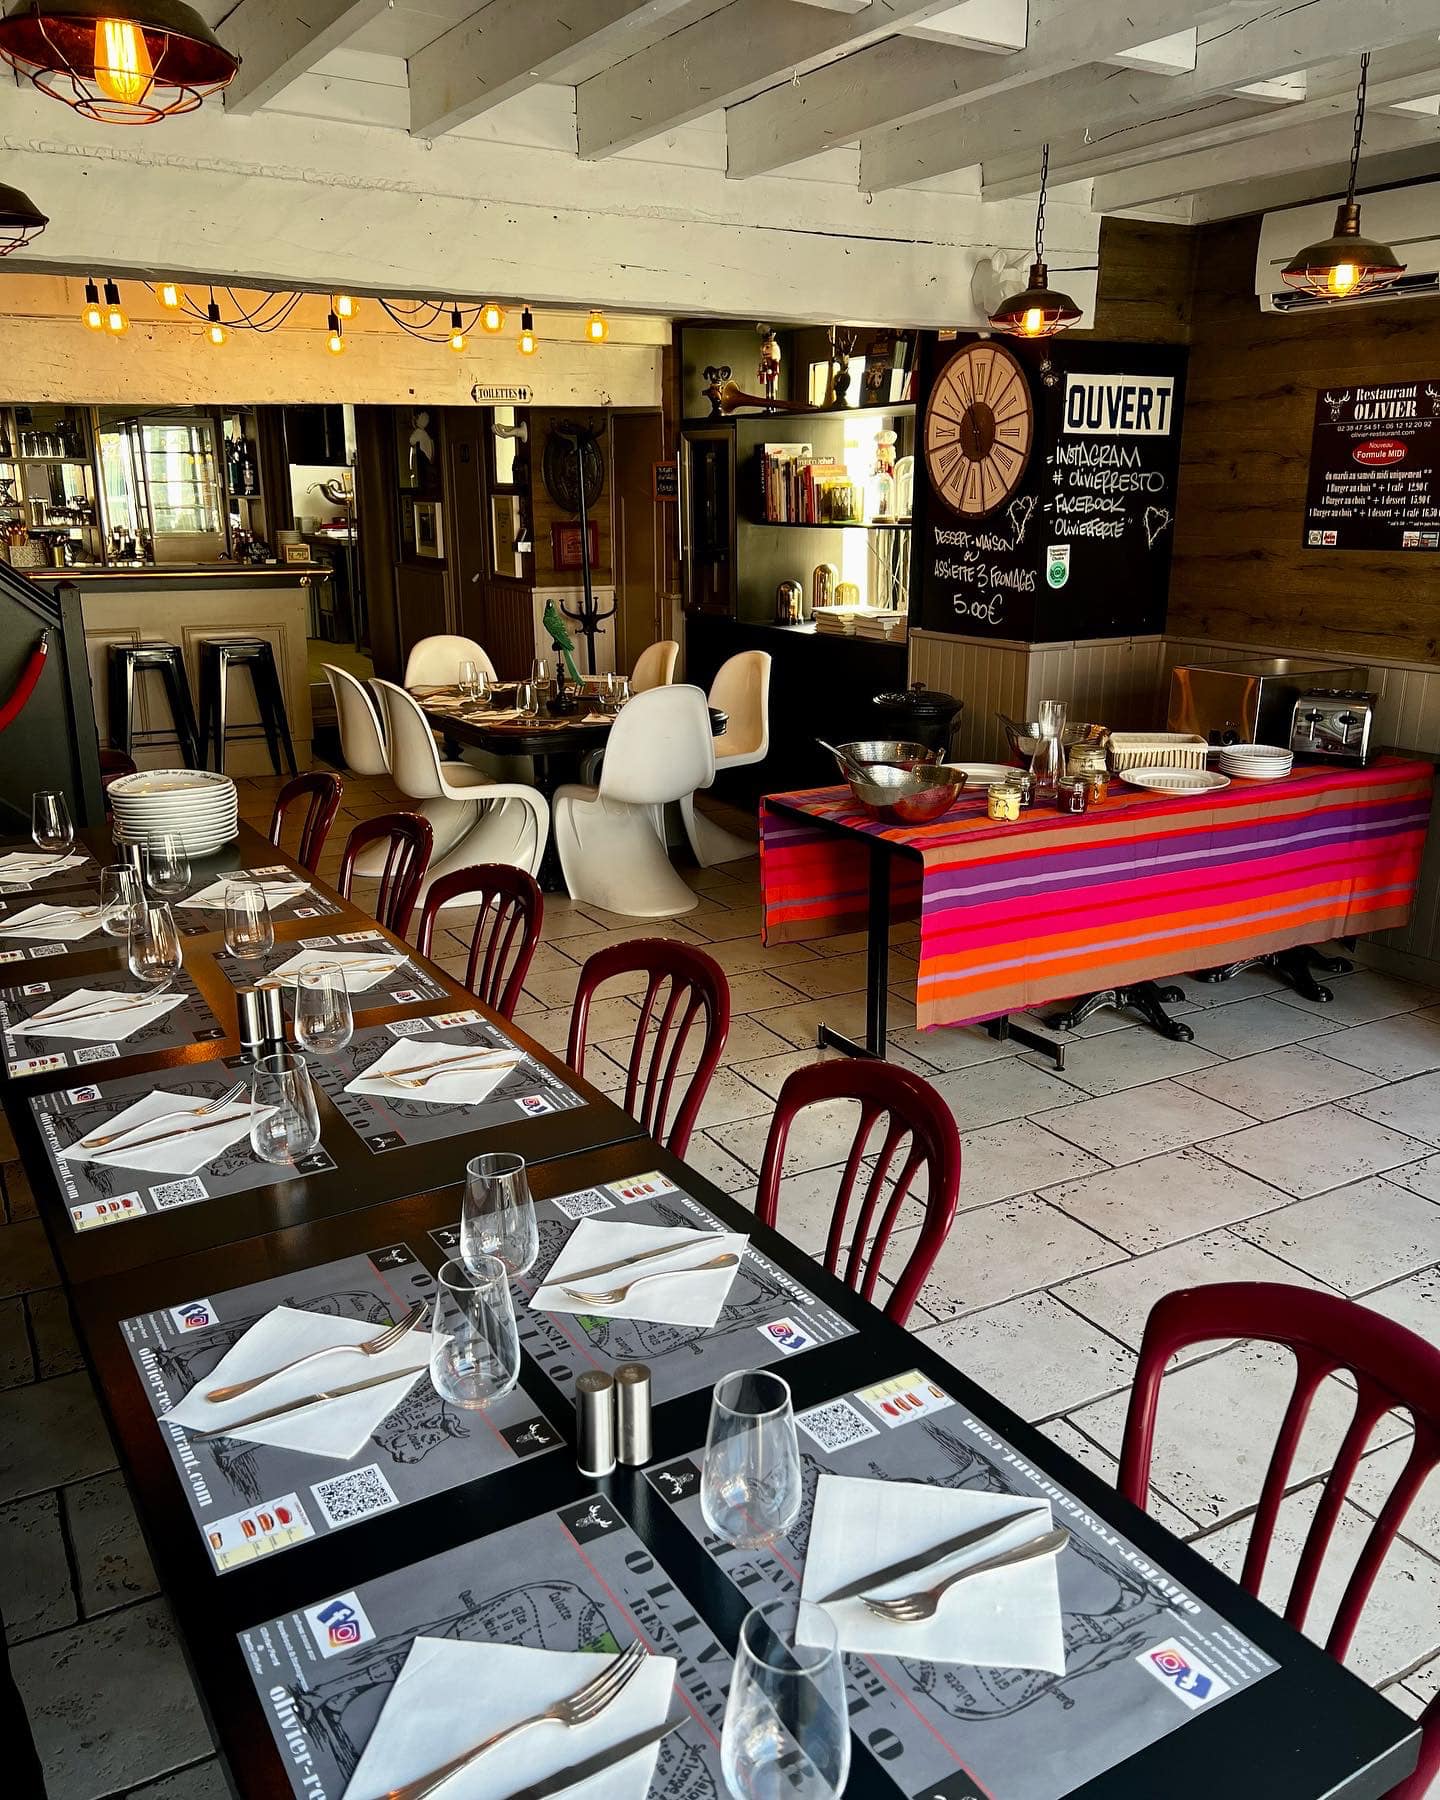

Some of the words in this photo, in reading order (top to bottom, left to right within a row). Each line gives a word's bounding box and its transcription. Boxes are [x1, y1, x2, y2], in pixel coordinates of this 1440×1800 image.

[478, 388, 518, 399] TOILETTES
[1067, 384, 1172, 431] OUVERT
[1356, 385, 1417, 401] Restaurant
[1354, 400, 1417, 420] OLIVIER
[1357, 451, 1387, 459] Formule
[1387, 449, 1405, 457] MIDI
[976, 563, 989, 588] 3
[990, 565, 1037, 592] FROMAGES
[962, 1418, 1202, 1614] olivier-restaurant.com
[549, 1591, 573, 1621] Culotte
[944, 1671, 977, 1708] Culotte
